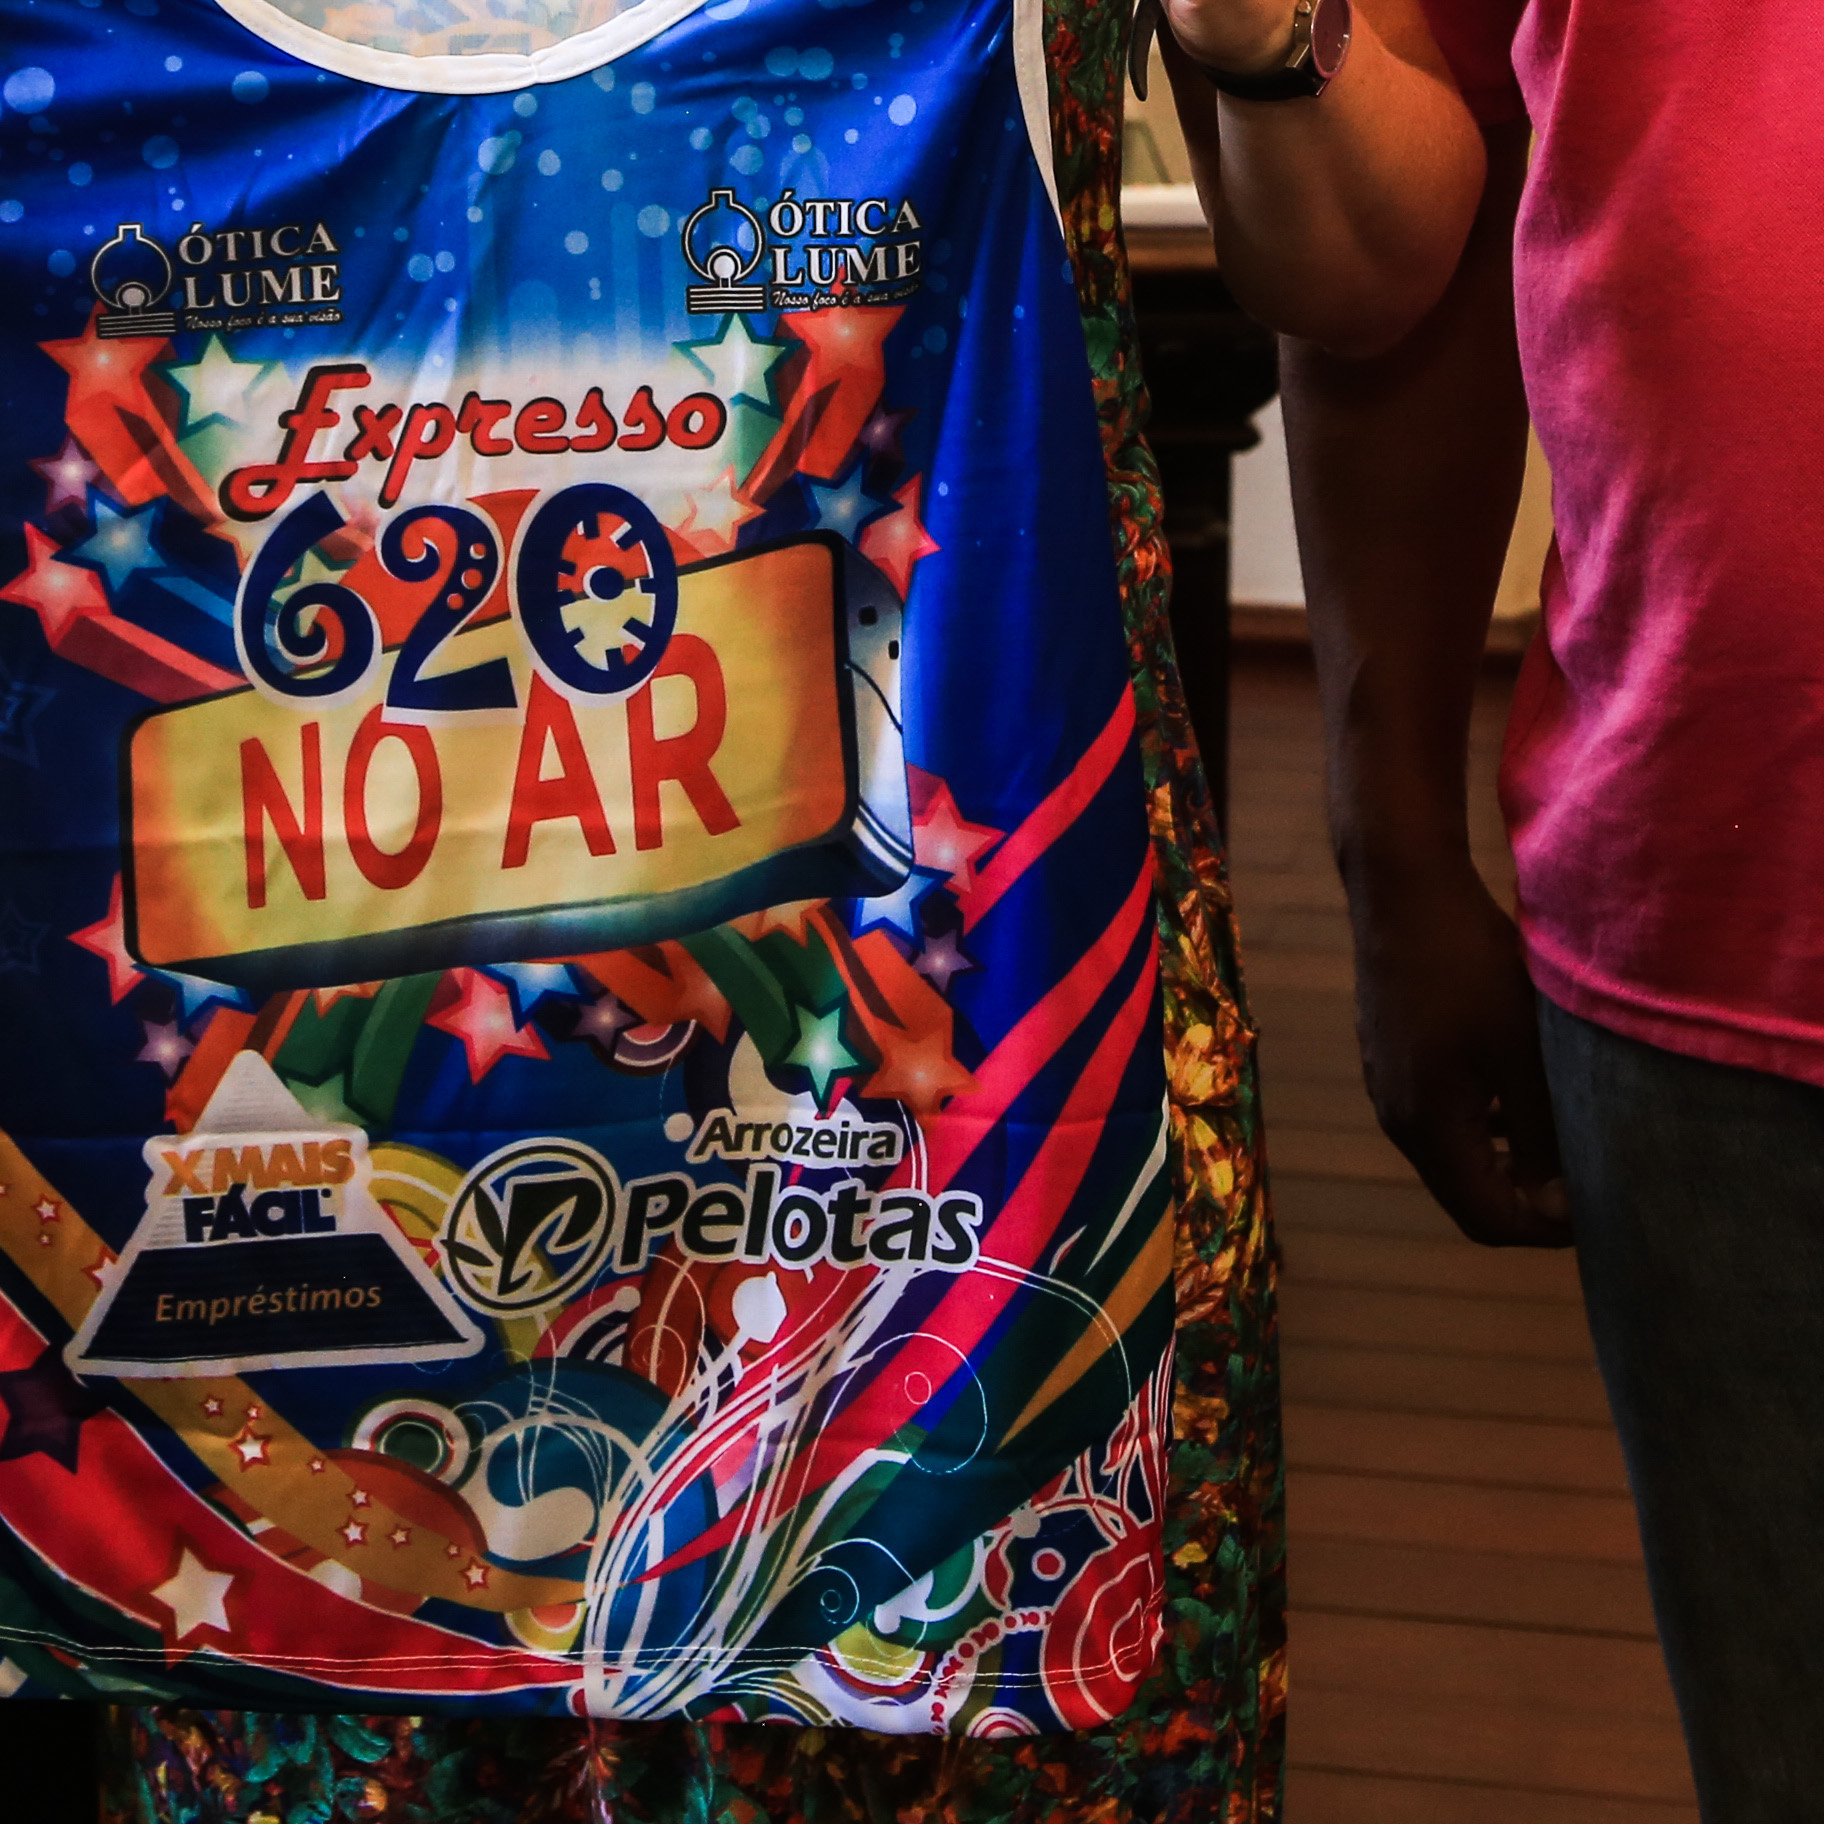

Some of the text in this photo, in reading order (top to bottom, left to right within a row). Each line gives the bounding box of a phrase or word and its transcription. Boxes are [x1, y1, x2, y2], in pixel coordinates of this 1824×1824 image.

[769, 191, 921, 237] ÓTICA
[178, 222, 338, 265] ÓTICA
[771, 241, 921, 285] LUME
[183, 264, 341, 310] LUME
[773, 290, 809, 306] Nosso
[813, 292, 836, 311] foco
[219, 363, 728, 522] Expresso
[236, 481, 680, 718] 620
[239, 633, 742, 910] NO AR
[693, 1115, 897, 1161] Arrozeira
[182, 1182, 337, 1244] FÁCIL
[619, 1170, 978, 1267] Pelotas
[155, 1283, 383, 1327] Empréstimos
